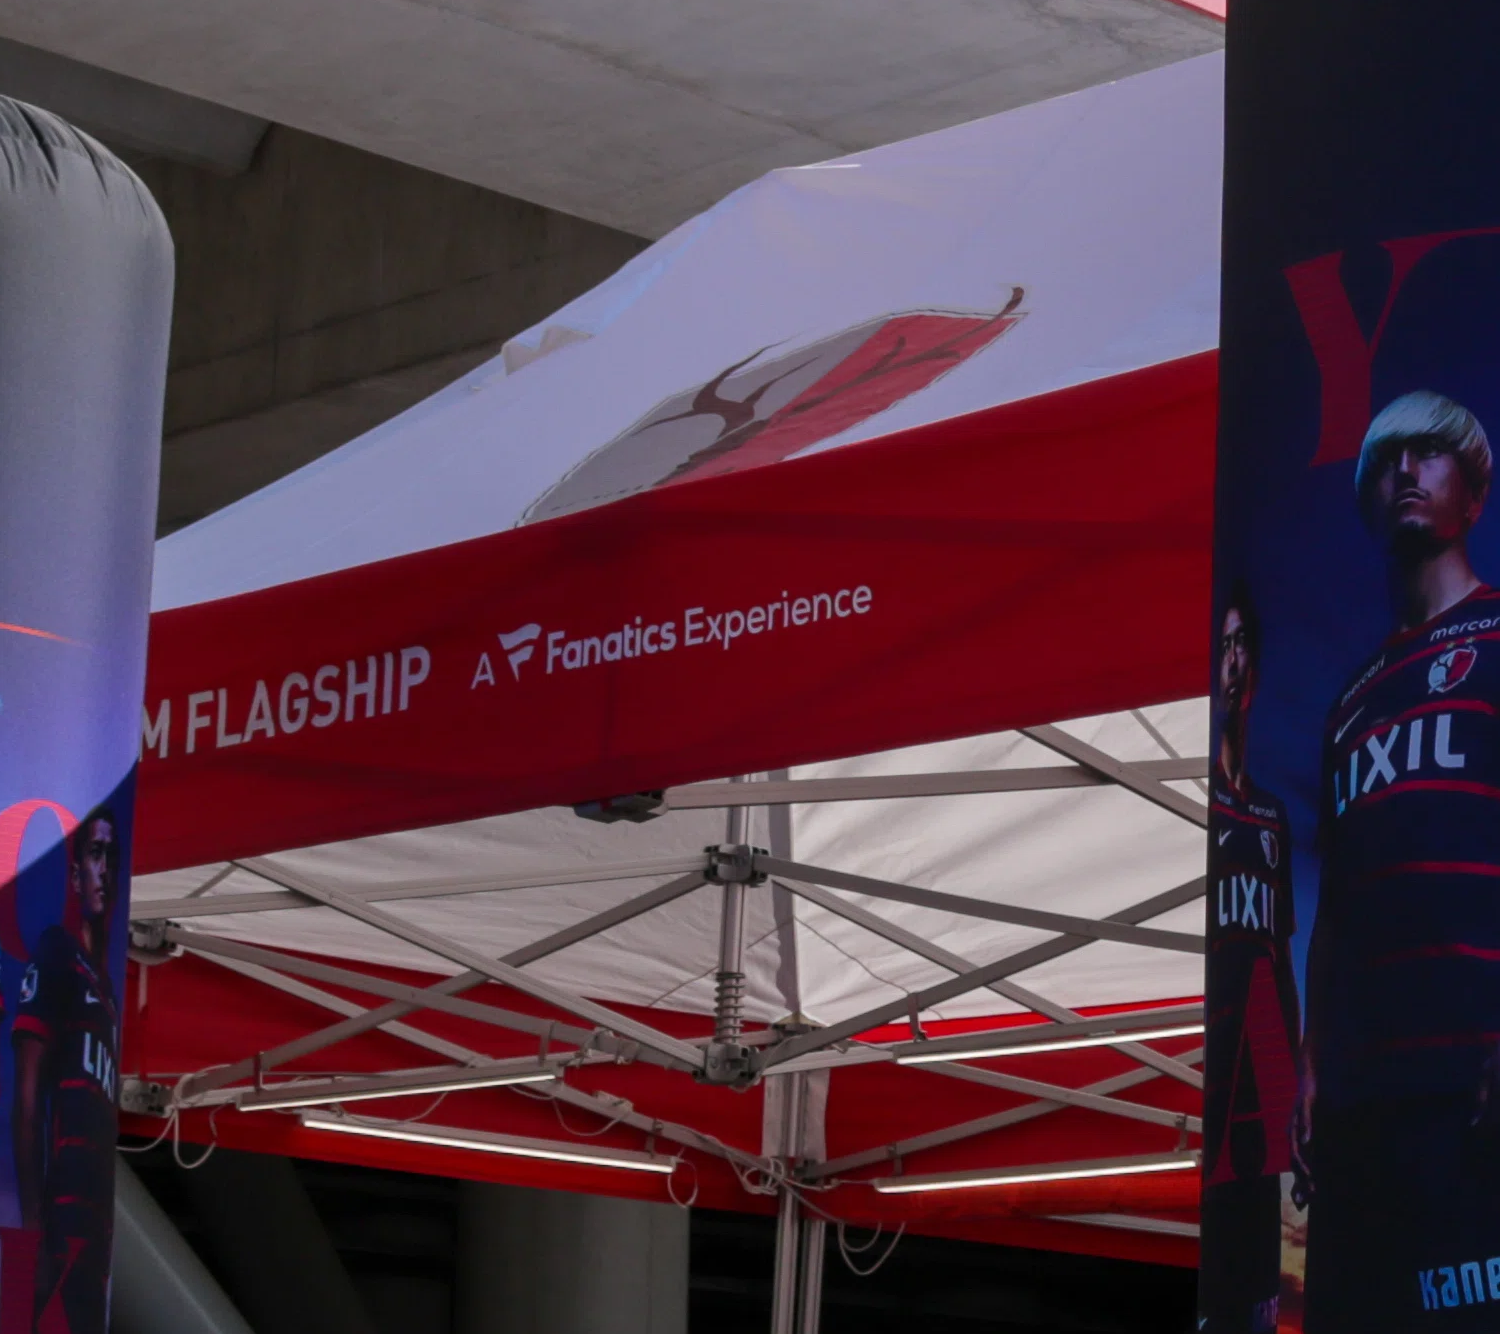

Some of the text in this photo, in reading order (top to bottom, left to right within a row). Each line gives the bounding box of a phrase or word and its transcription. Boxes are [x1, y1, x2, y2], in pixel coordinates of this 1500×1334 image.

[186, 644, 431, 755] FLAGSHIP
[545, 617, 678, 676] Fanatics
[683, 582, 874, 651] Experience
[1333, 713, 1466, 817] LIXIL
